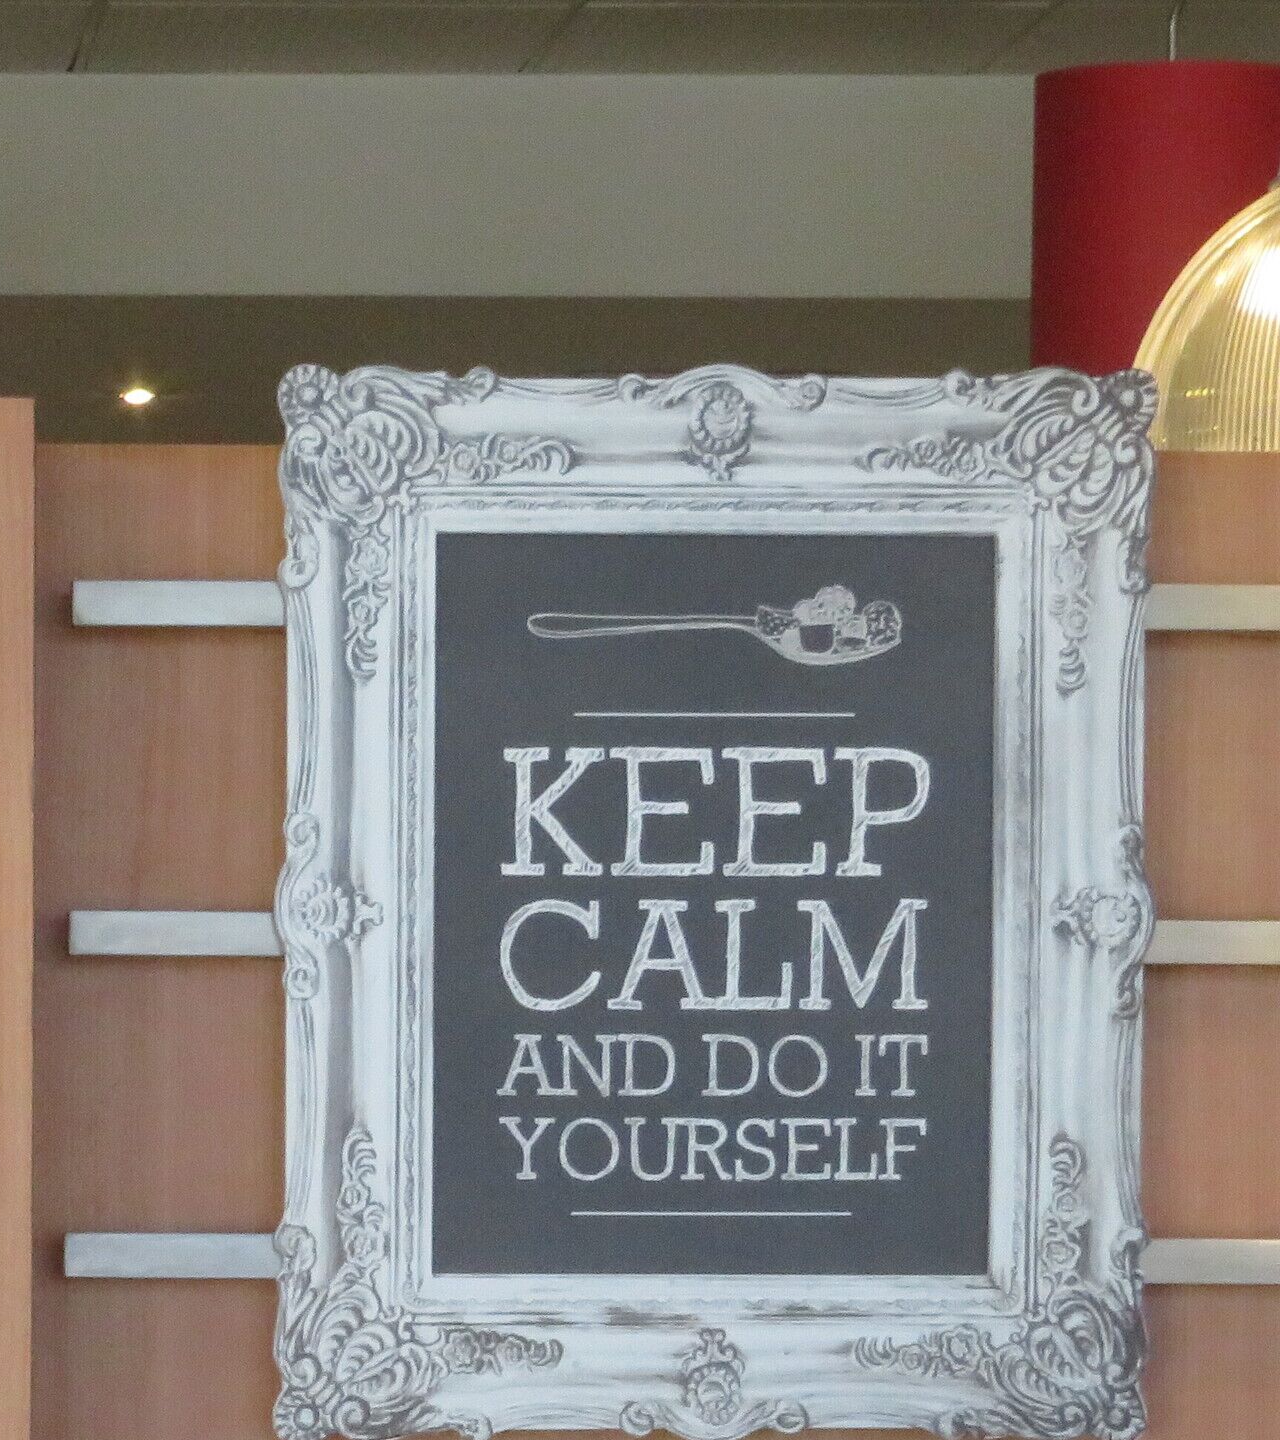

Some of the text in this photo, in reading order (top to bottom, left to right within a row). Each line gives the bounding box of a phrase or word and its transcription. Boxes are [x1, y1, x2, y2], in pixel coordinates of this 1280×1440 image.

[500, 746, 931, 877] KEEP
[499, 898, 929, 1011] CALM
[496, 1033, 929, 1099] AND DO IT
[499, 1117, 928, 1182] YOURSELF
